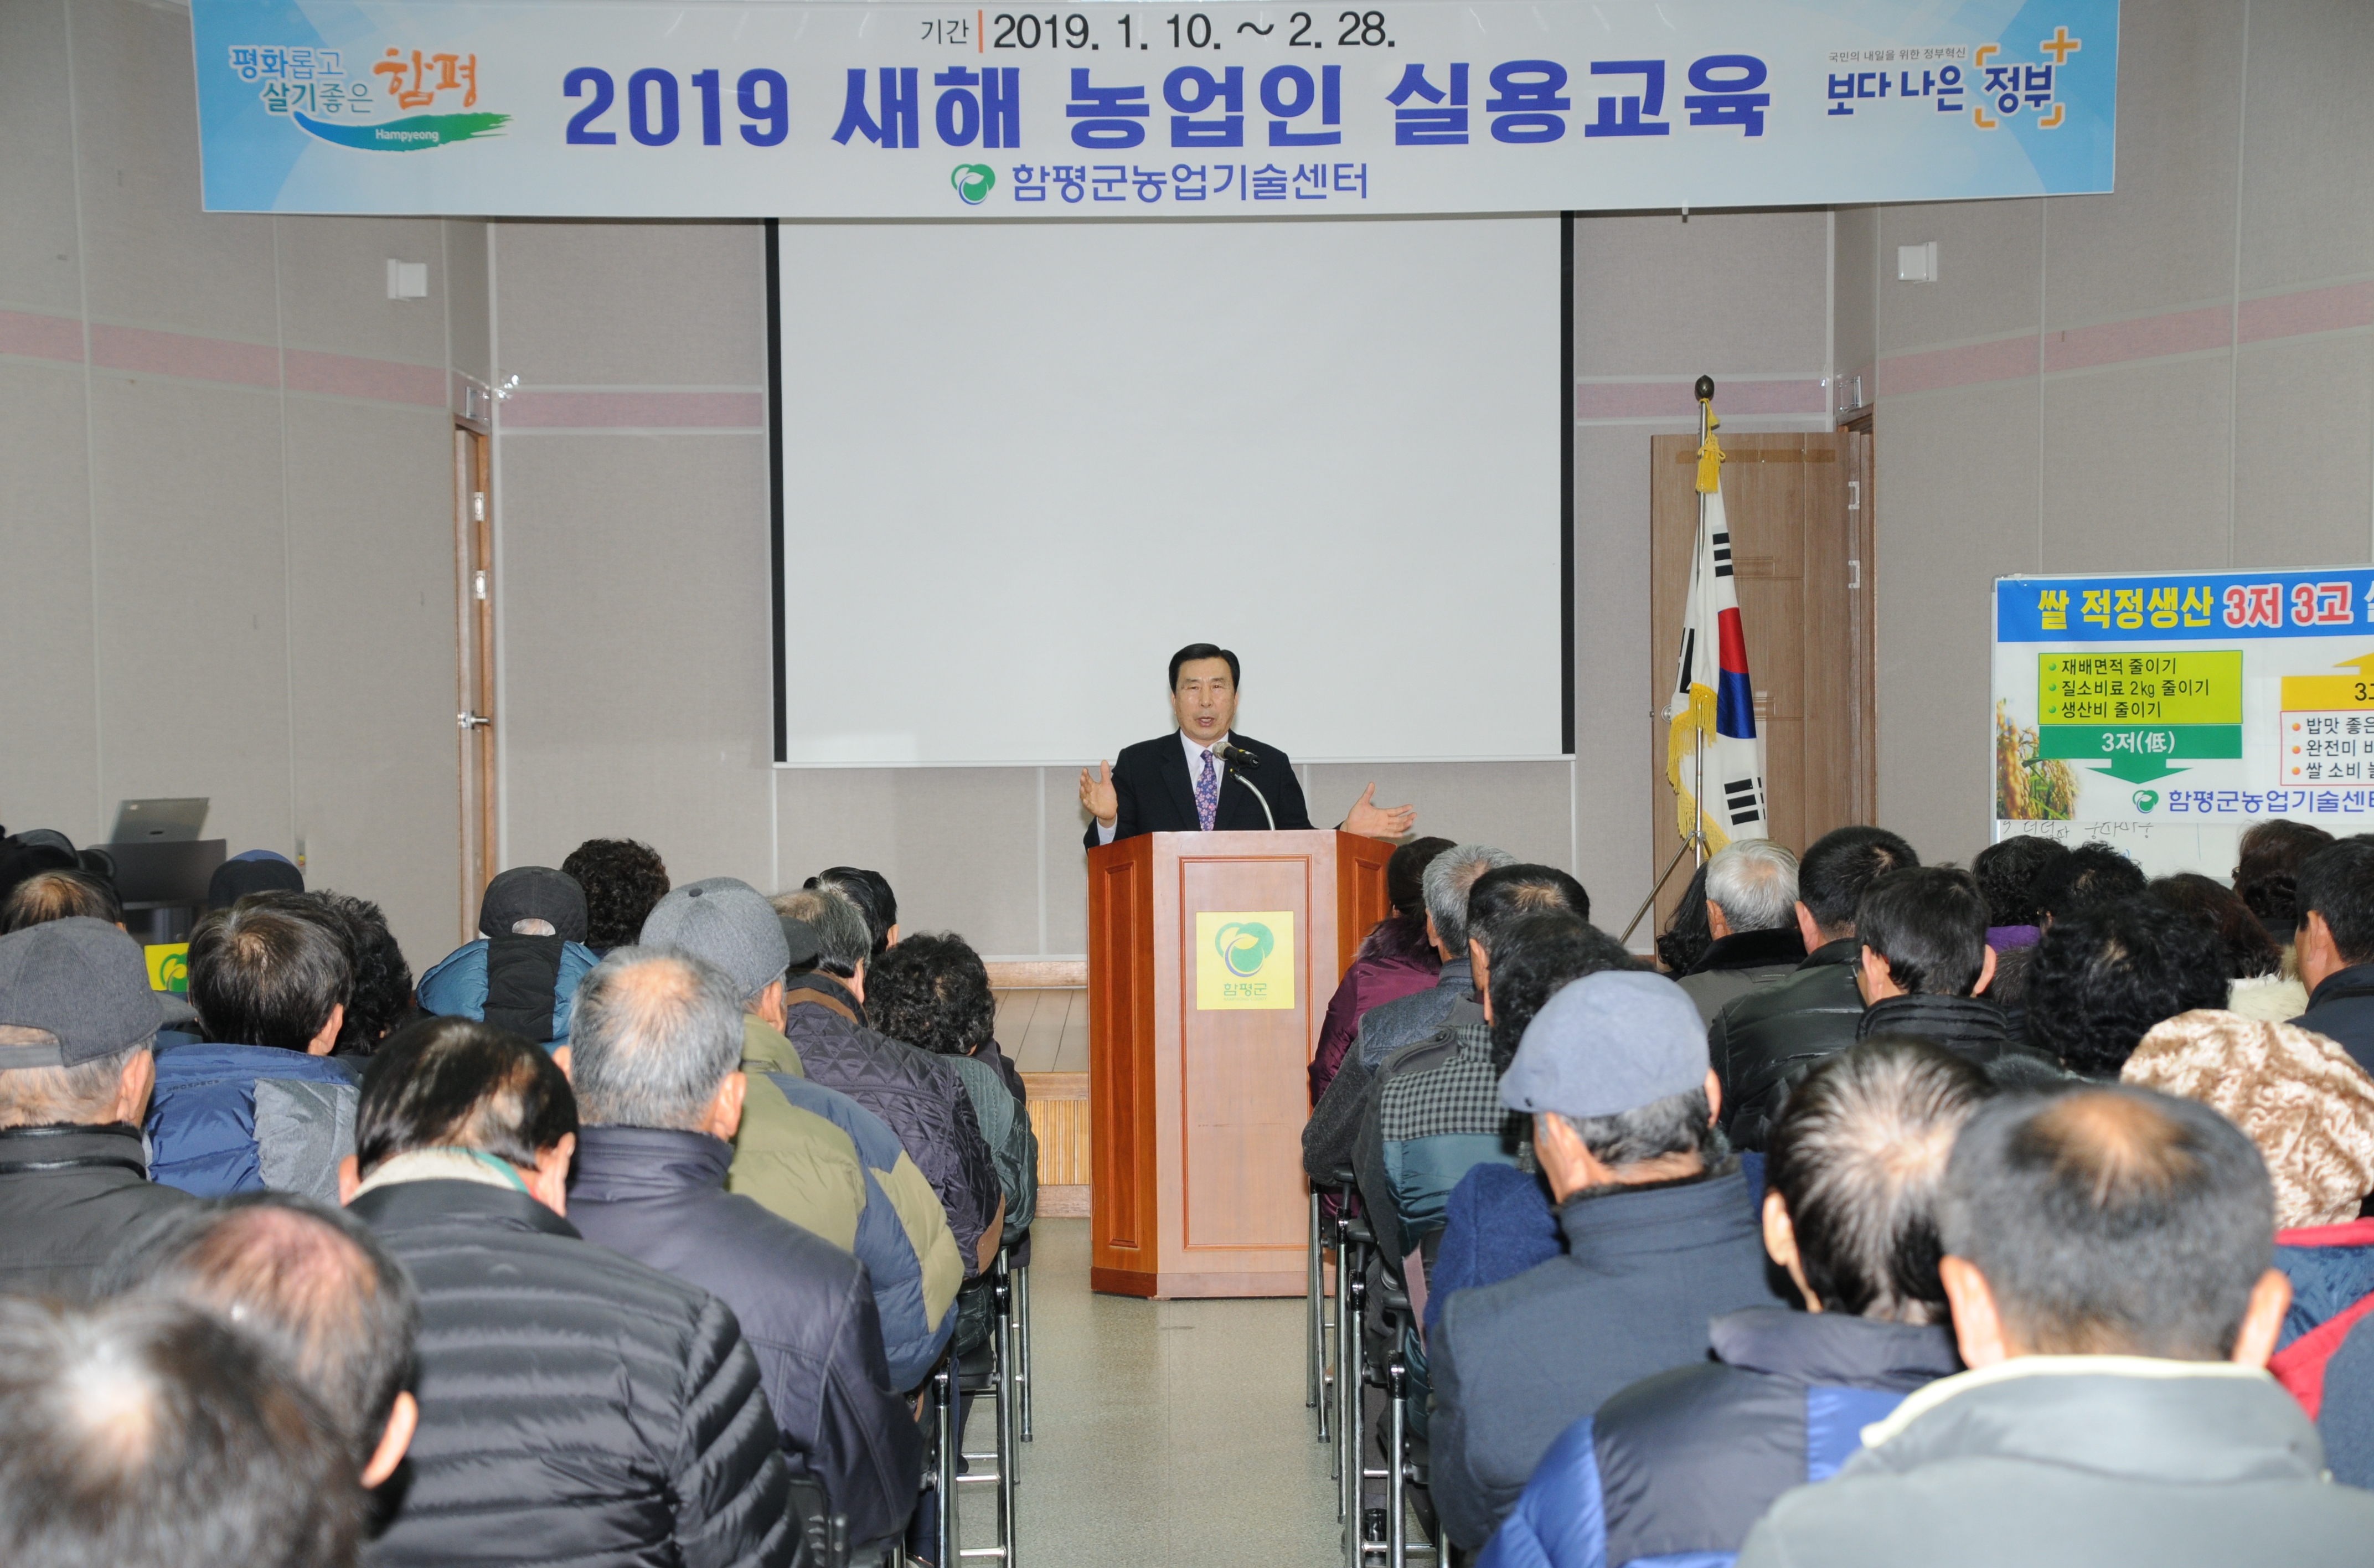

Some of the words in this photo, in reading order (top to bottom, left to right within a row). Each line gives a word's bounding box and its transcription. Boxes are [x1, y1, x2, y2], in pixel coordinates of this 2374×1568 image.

[921, 18, 969, 44] 기간
[994, 14, 1098, 50] 2019.
[1118, 14, 1148, 49] 1.
[1168, 13, 1221, 49] 10.
[1289, 12, 1322, 48] 2.
[1338, 11, 1395, 47] 28.
[233, 49, 343, 79] 평화롭고
[1829, 51, 1860, 63] 국민의
[1865, 50, 1895, 61] 내일을
[1899, 49, 1920, 60] 위한
[1923, 48, 1966, 59] 정부혁신
[374, 48, 477, 110] 함평
[264, 82, 373, 112] 살기좋은
[1828, 72, 1891, 116] 보다
[1901, 65, 1963, 112] 나은
[1985, 65, 2052, 114] 정부
[562, 66, 790, 147] 2019
[831, 65, 1020, 148] 새해
[1066, 64, 1341, 149] 농업인
[1386, 54, 1770, 146] 실용교육
[376, 129, 439, 142] Hampyeong
[1012, 163, 1367, 203] 함평군농업기술센터
[2038, 590, 2069, 630] 쌀
[2081, 586, 2213, 629] 적정생산
[2226, 587, 2279, 625] 3저
[2295, 585, 2350, 623] 3고
[2062, 659, 2124, 675] 재배면적
[2128, 658, 2177, 675] 줄이기
[2062, 680, 2125, 697] 질소비료
[2130, 680, 2155, 698] 2kg
[2161, 679, 2210, 696] 줄이기
[2062, 702, 2108, 719] 생산비
[2114, 702, 2161, 718] 줄이기
[2306, 718, 2339, 734] 밥맛
[2102, 730, 2176, 754] 3저(低)
[2306, 739, 2356, 757] 완전미
[2306, 762, 2322, 779] 쌀
[2328, 762, 2360, 779] 소비
[1224, 983, 1267, 996] 함평군
